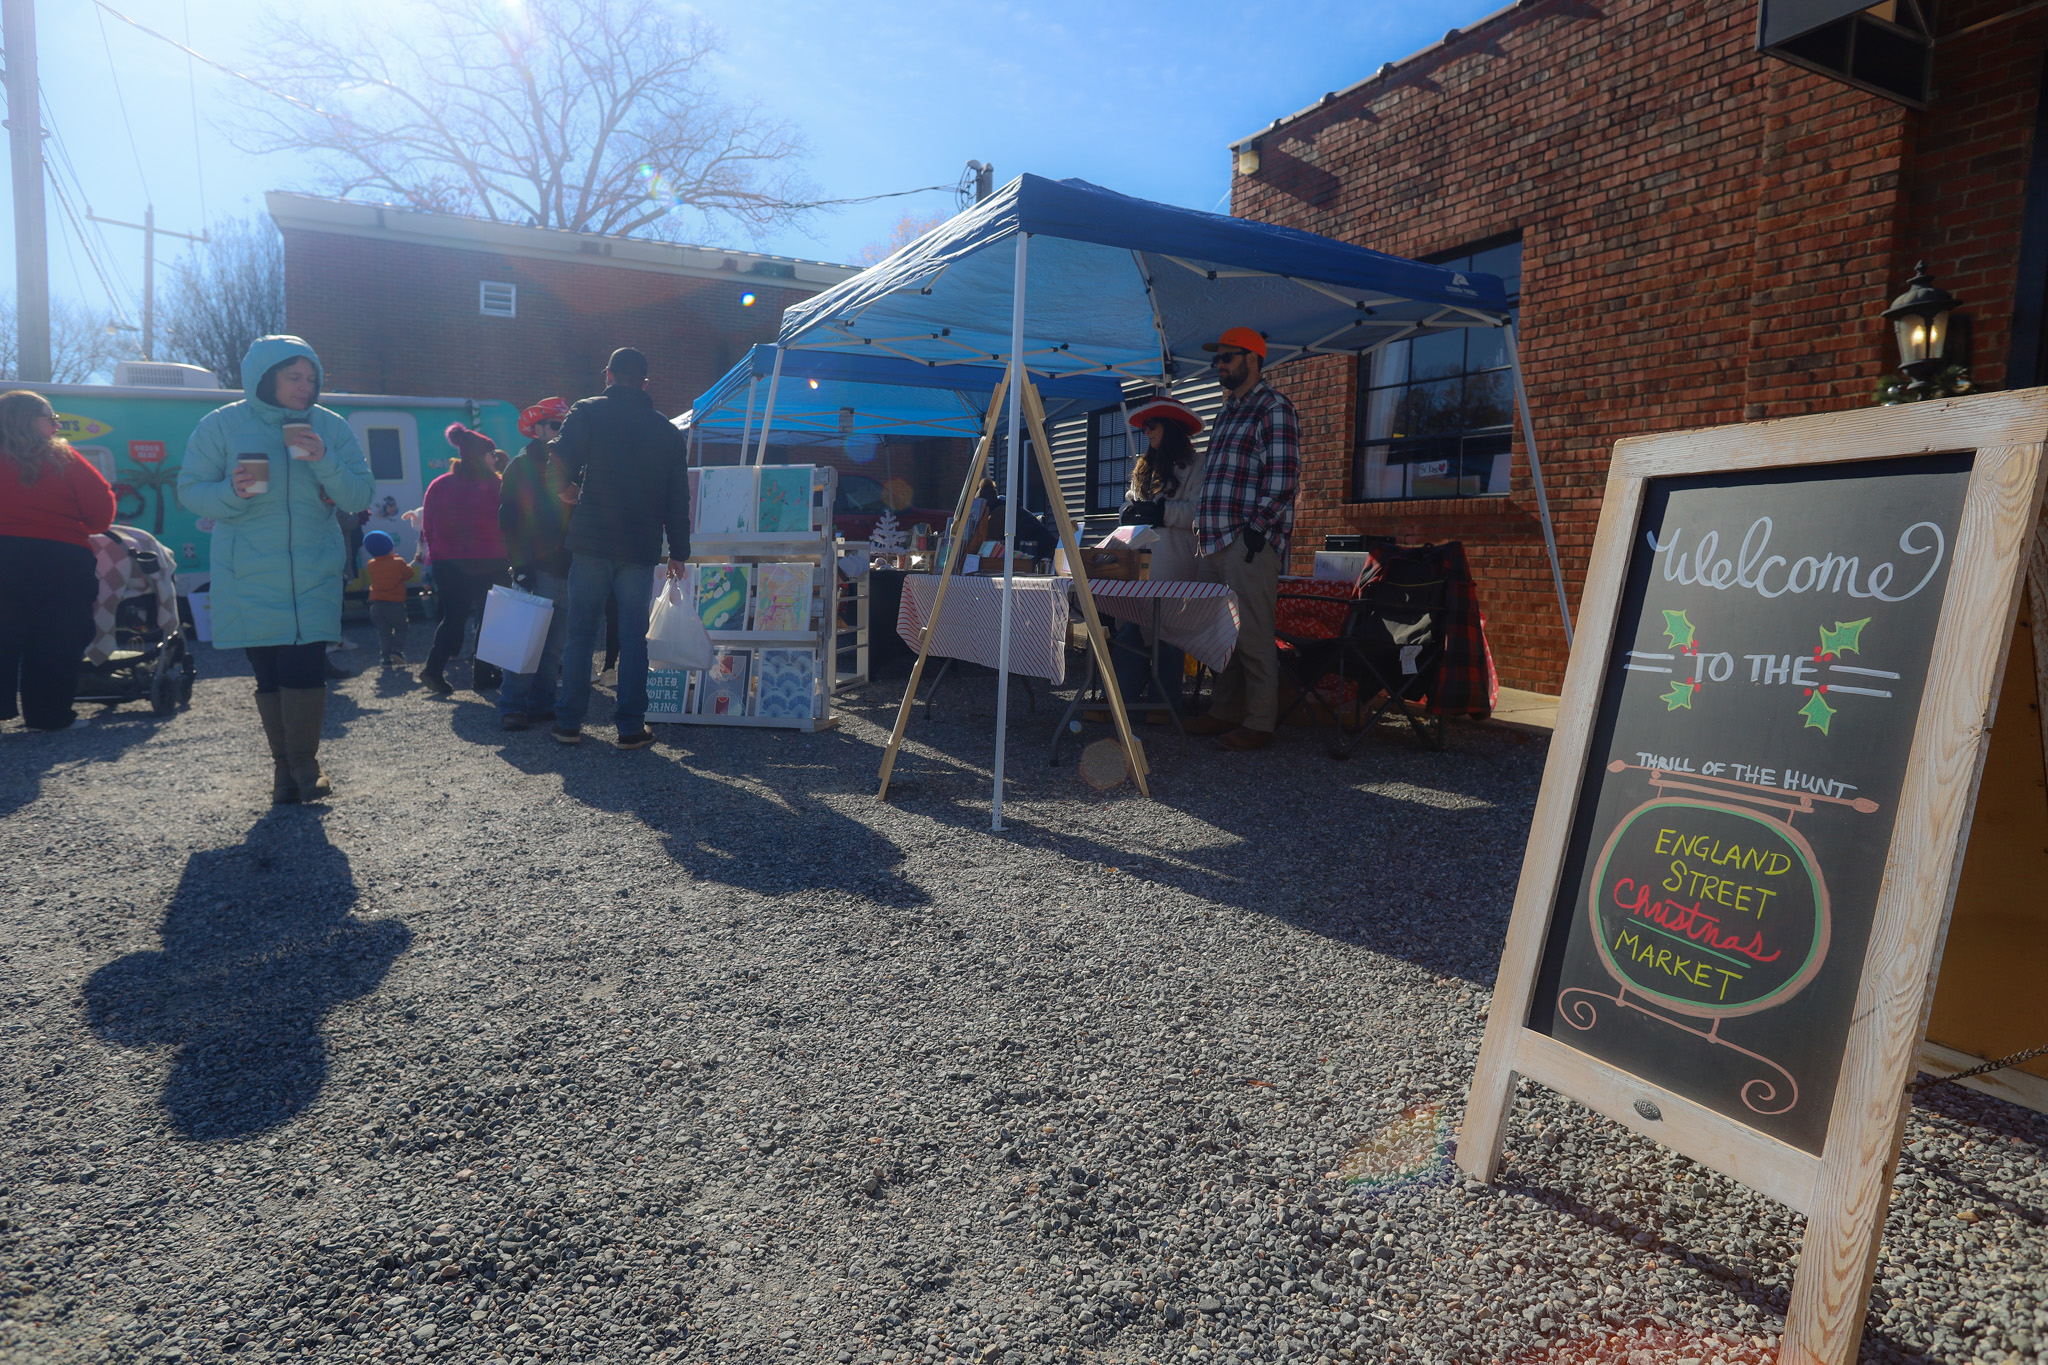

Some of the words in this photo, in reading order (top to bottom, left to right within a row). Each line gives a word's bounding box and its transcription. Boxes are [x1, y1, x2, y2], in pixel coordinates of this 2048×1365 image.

[1646, 516, 1945, 602] Welcome
[1684, 651, 1734, 684] TO
[1743, 654, 1819, 687] THE
[1636, 751, 1696, 772] THRILL
[1702, 761, 1727, 776] OF
[1731, 763, 1777, 786] THE
[1783, 769, 1858, 799] HUNT
[1655, 828, 1792, 875] ENGLAND
[1662, 859, 1777, 919] STREET
[1613, 877, 1781, 962] Christmas
[1614, 929, 1743, 1000] MARKET
